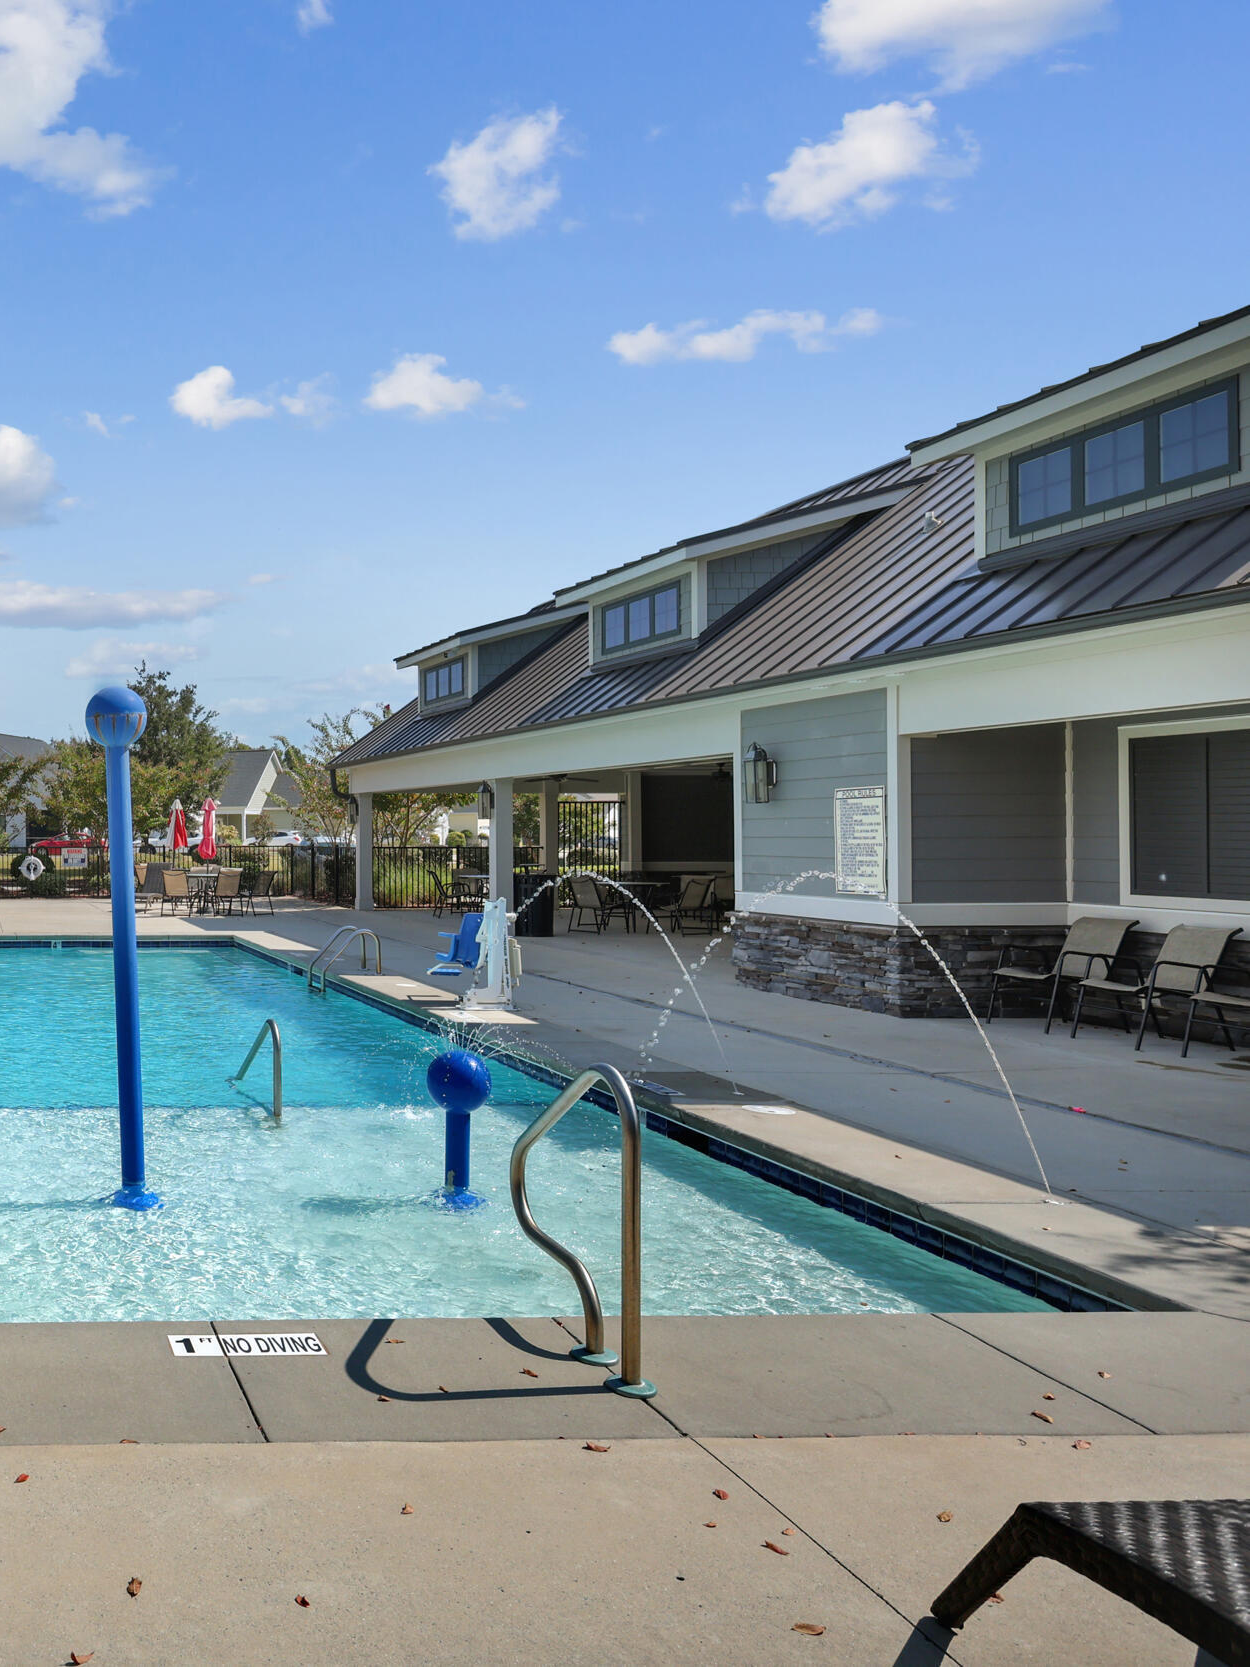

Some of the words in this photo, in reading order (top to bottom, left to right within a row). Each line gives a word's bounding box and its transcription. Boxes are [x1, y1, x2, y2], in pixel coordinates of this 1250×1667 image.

[857, 789, 876, 797] RULES
[175, 1338, 196, 1353] 1
[222, 1338, 252, 1354] NO
[254, 1336, 323, 1353] DIVING
